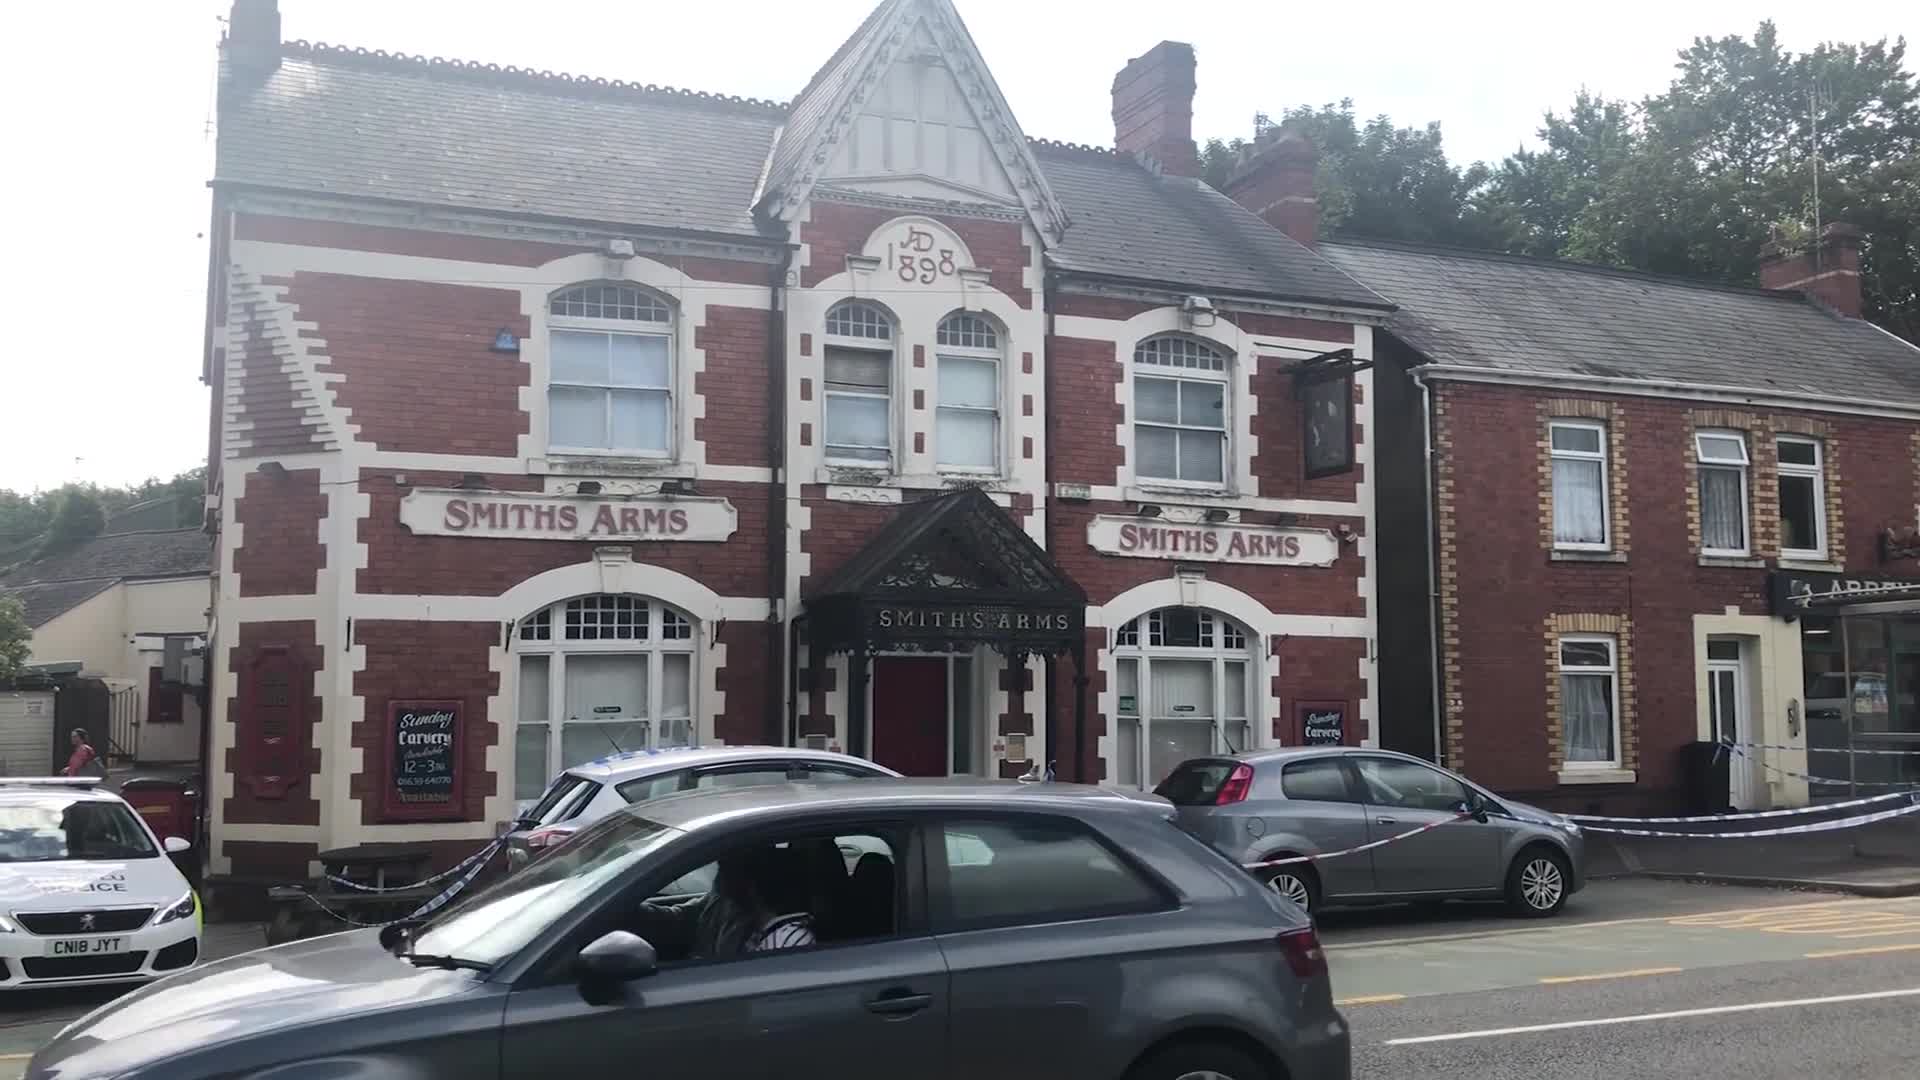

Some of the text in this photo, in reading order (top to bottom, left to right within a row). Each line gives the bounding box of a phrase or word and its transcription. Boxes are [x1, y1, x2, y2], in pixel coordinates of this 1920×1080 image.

[888, 242, 955, 285] 1898
[444, 499, 689, 535] SMITHS ARMS
[1119, 523, 1300, 558] SMITHS ARMS
[879, 609, 1069, 630] SMITH'S ARMS
[400, 711, 454, 729] Sunday
[398, 731, 452, 746] Carvery
[54, 938, 121, 954] CN18 JYT
